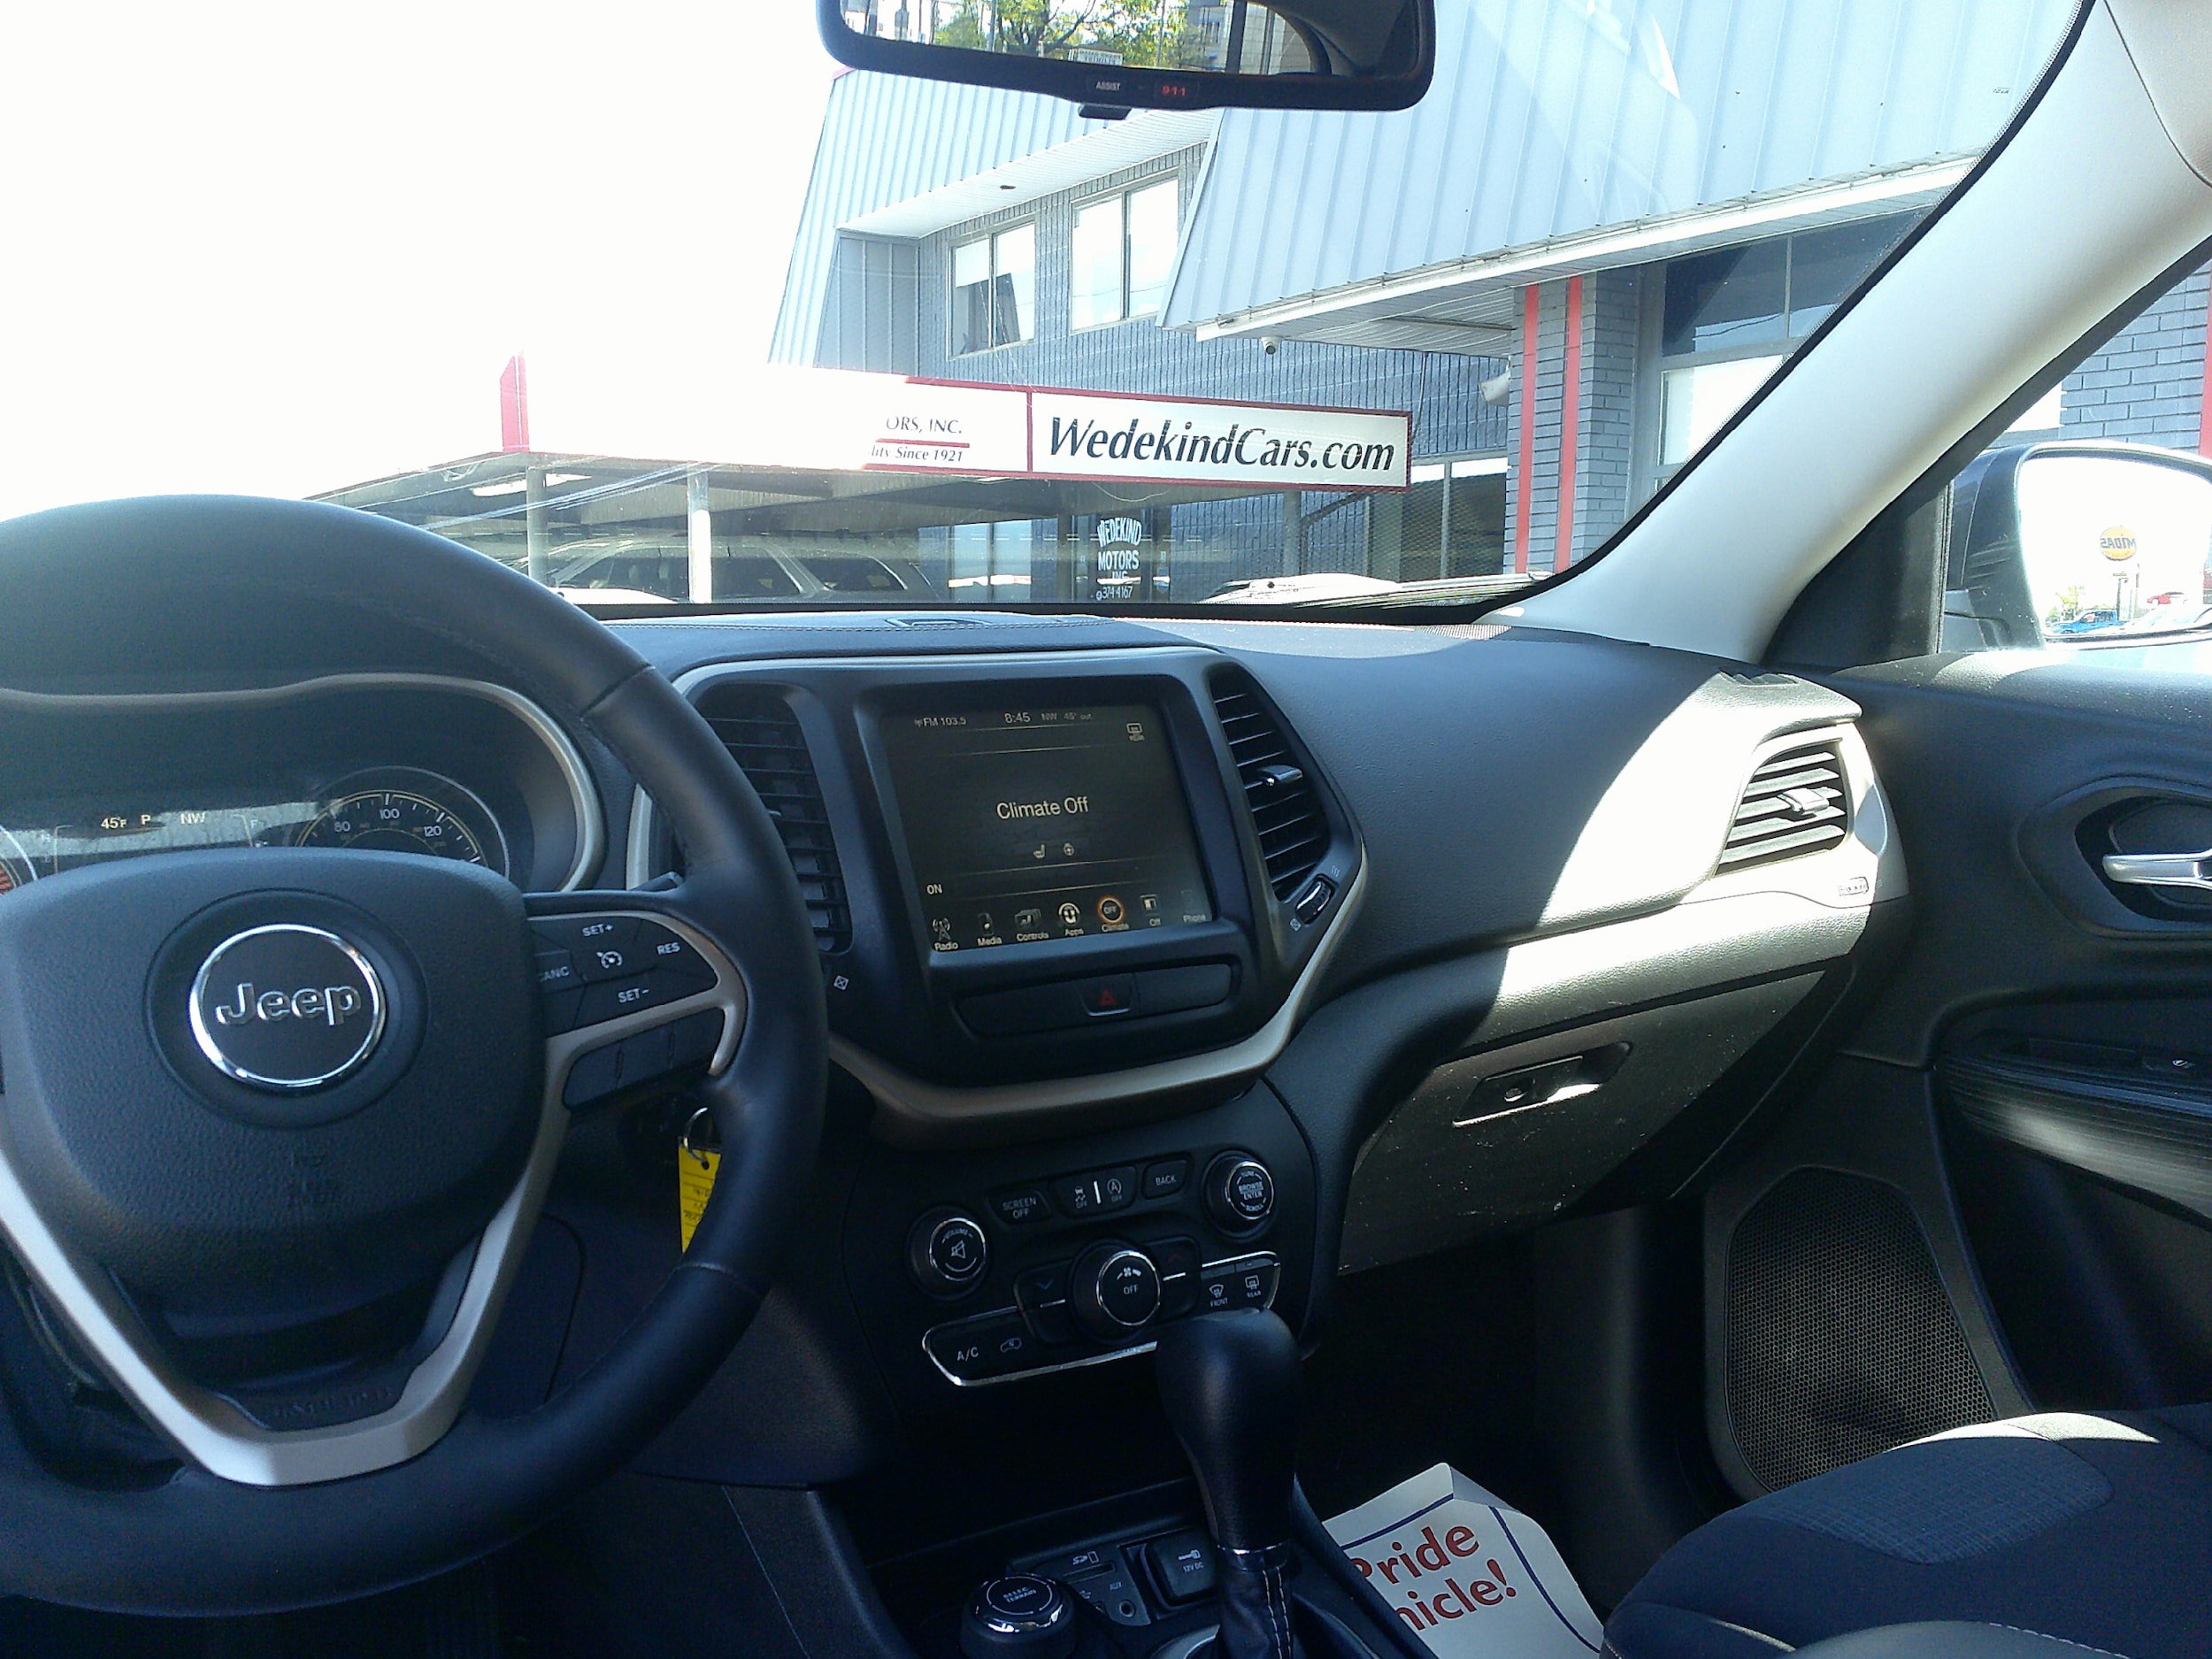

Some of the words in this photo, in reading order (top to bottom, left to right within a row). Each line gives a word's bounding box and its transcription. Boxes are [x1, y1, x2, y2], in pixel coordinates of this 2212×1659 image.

[1095, 81, 1121, 90] ASSIST
[1161, 85, 1187, 96] 911
[929, 419, 963, 434] INC.
[1050, 417, 1395, 471] WedekindCars.com
[895, 447, 929, 460] Since
[934, 449, 963, 462] 1921
[1097, 517, 1141, 548] WEDEKIND
[1098, 549, 1140, 571] MOTORS
[923, 718, 939, 726] FM
[940, 717, 966, 726] 103.5
[1004, 711, 1031, 724] 8:45
[380, 808, 400, 819] 100
[996, 800, 1061, 820] Climate
[1064, 796, 1089, 813] Off
[142, 814, 151, 825] P
[180, 811, 206, 825] NW
[424, 825, 442, 837] 120
[926, 884, 943, 895] ON
[1016, 931, 1049, 942] Controls
[1064, 927, 1084, 937] Apps
[934, 941, 959, 951] Radio
[977, 936, 1002, 946] Media
[657, 942, 680, 955] RES
[215, 982, 361, 1025] Jeep
[1156, 1175, 1177, 1186] BACK
[1002, 1197, 1036, 1210] SCREEN
[1012, 1208, 1030, 1219] OFF
[1123, 1285, 1139, 1294] OFF
[1210, 1298, 1228, 1307] FRONT
[956, 1347, 979, 1362] A/C
